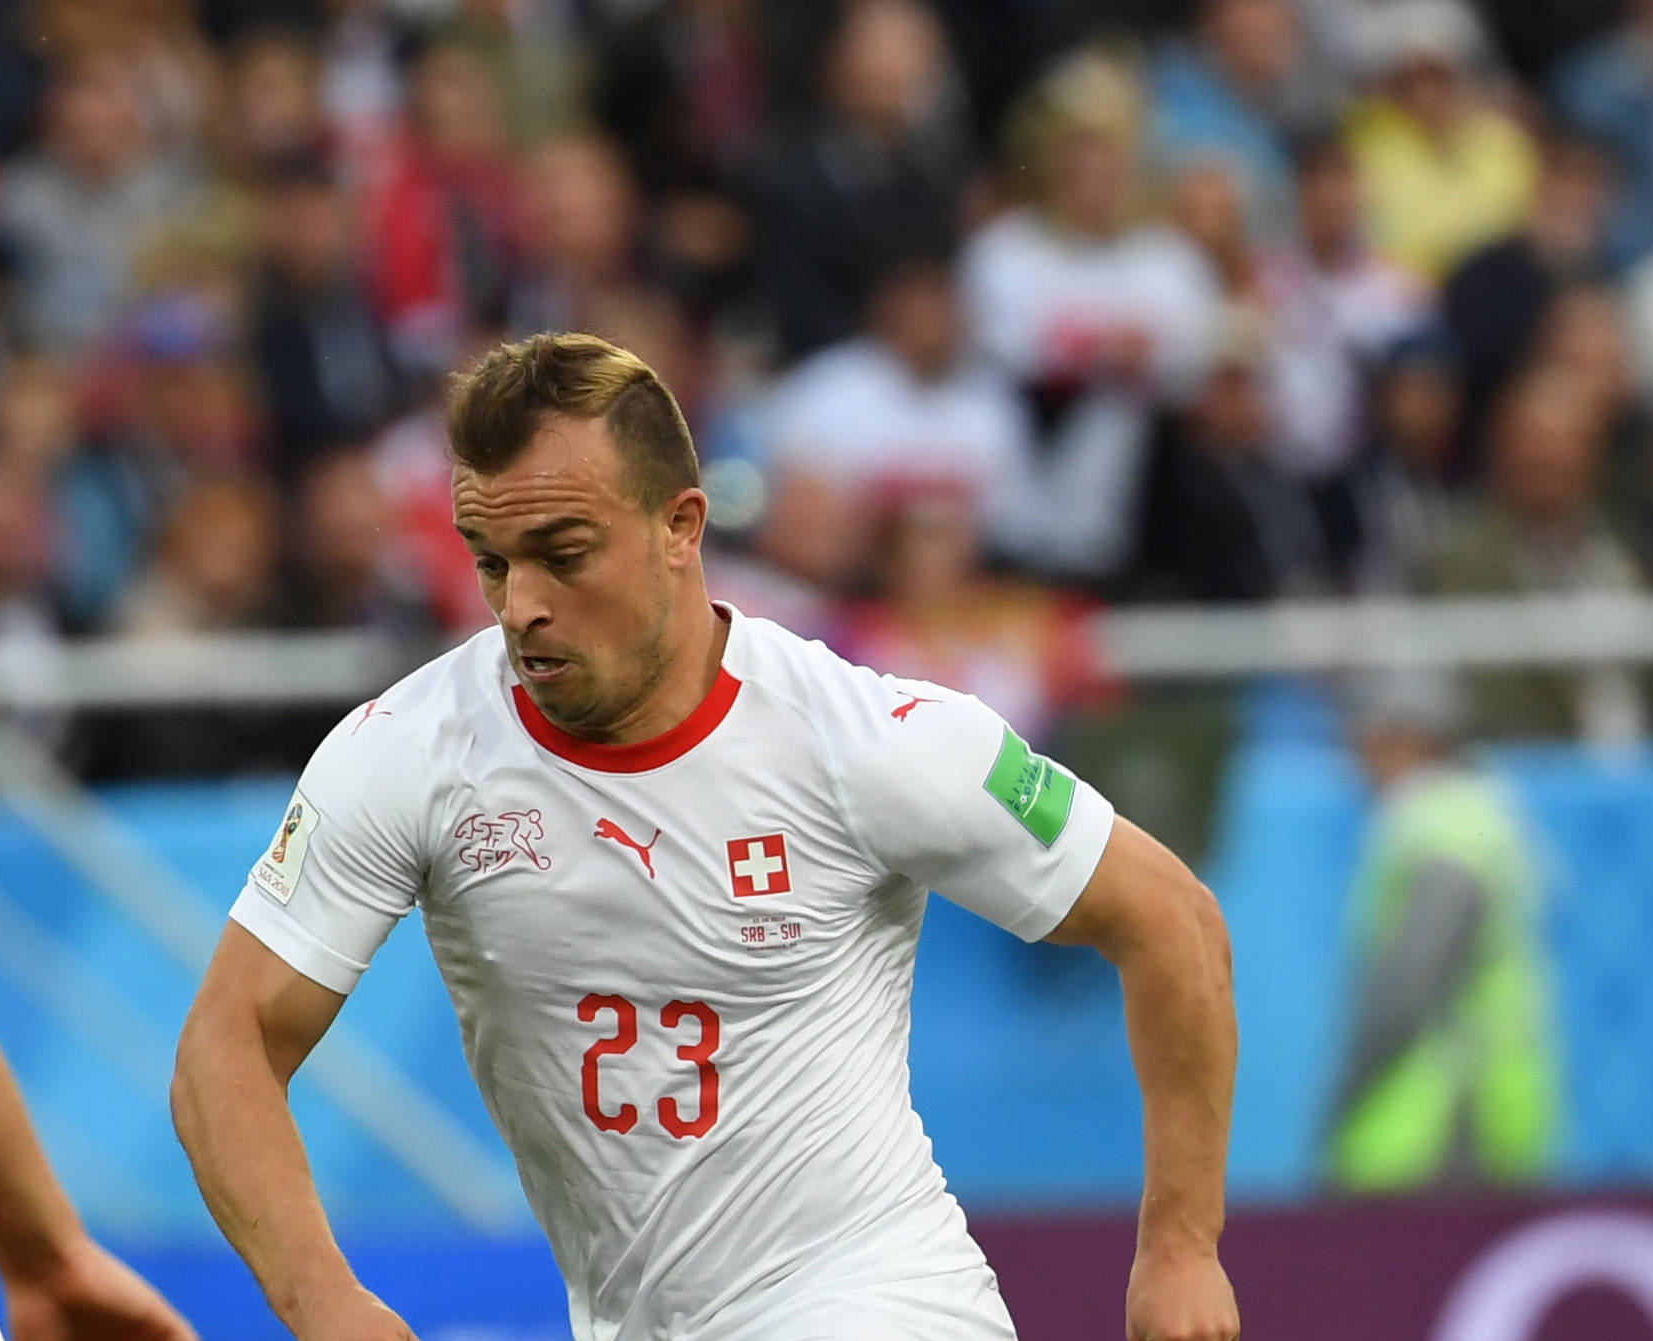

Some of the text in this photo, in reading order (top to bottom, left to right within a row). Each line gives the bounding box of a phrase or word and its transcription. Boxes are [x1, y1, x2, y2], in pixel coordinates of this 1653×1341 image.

[741, 925, 765, 943] SRB
[780, 922, 802, 941] SUI
[577, 992, 720, 1139] 23
